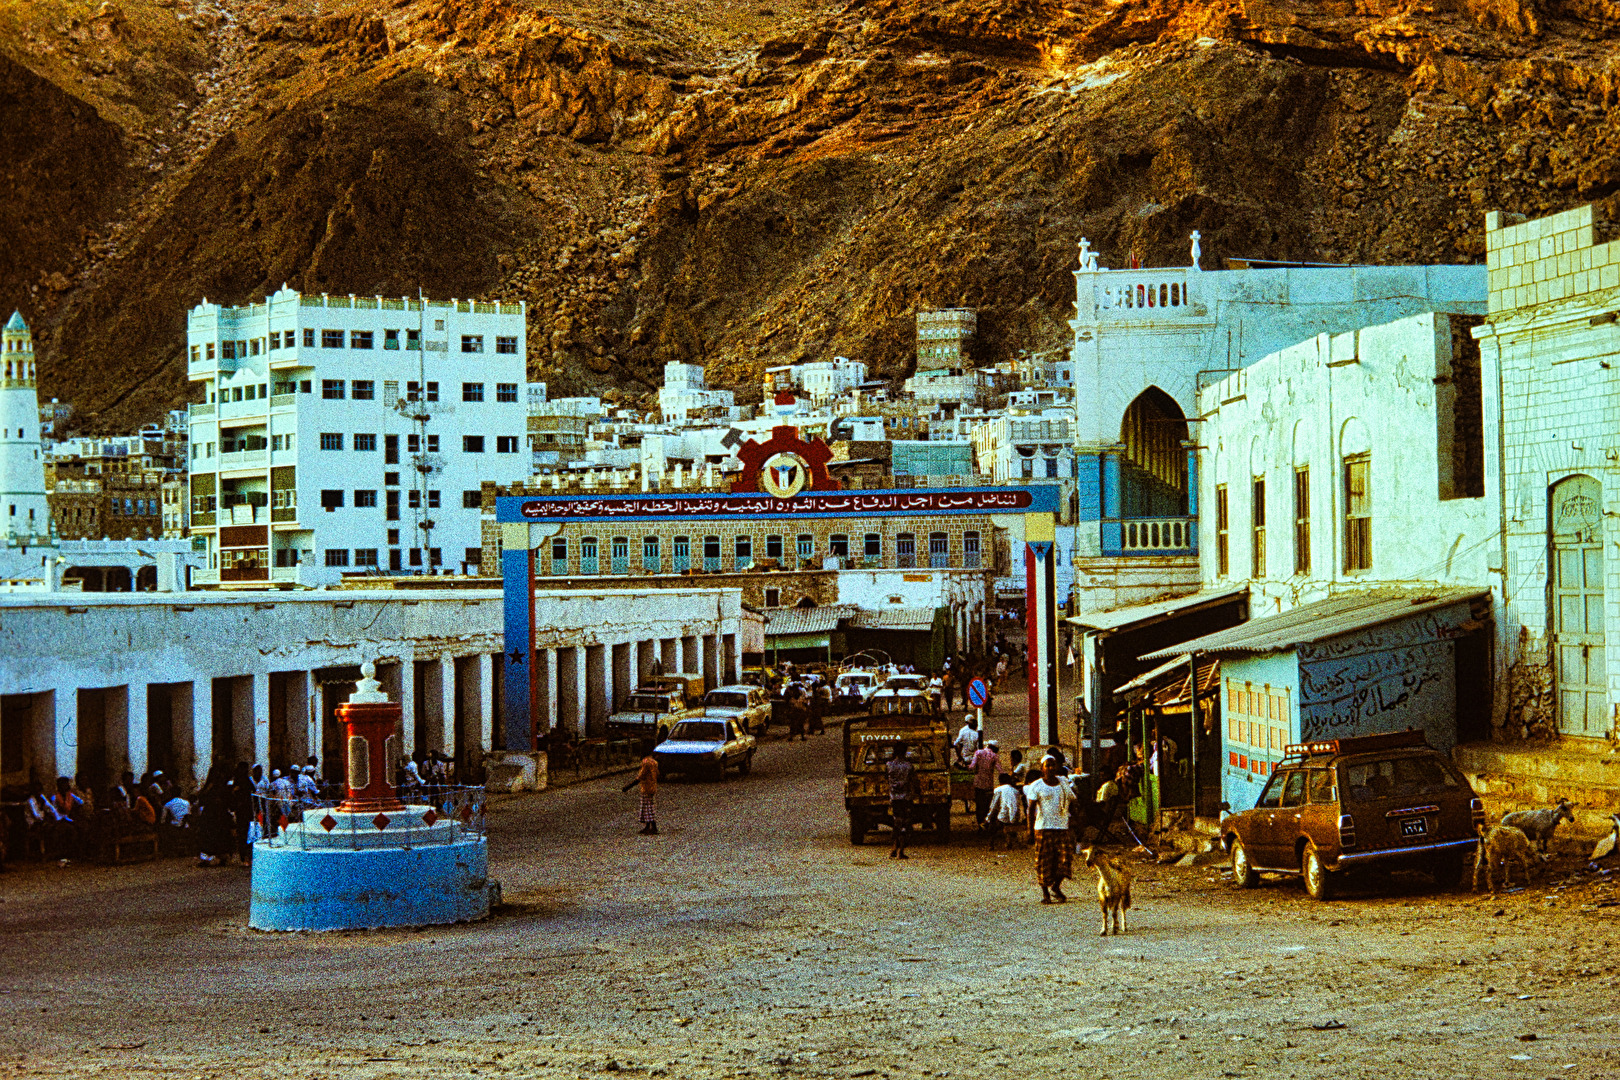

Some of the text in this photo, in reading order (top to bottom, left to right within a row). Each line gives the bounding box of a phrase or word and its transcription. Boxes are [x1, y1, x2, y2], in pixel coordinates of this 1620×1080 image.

[641, 500, 682, 512] الخطه
[684, 500, 720, 513] وتنفيذ
[721, 499, 773, 513] اليمنيه
[818, 498, 851, 510] عن
[853, 496, 897, 511] الدفاع
[900, 495, 933, 510] اجل
[938, 495, 973, 508] من
[977, 493, 1017, 508] لنناضل
